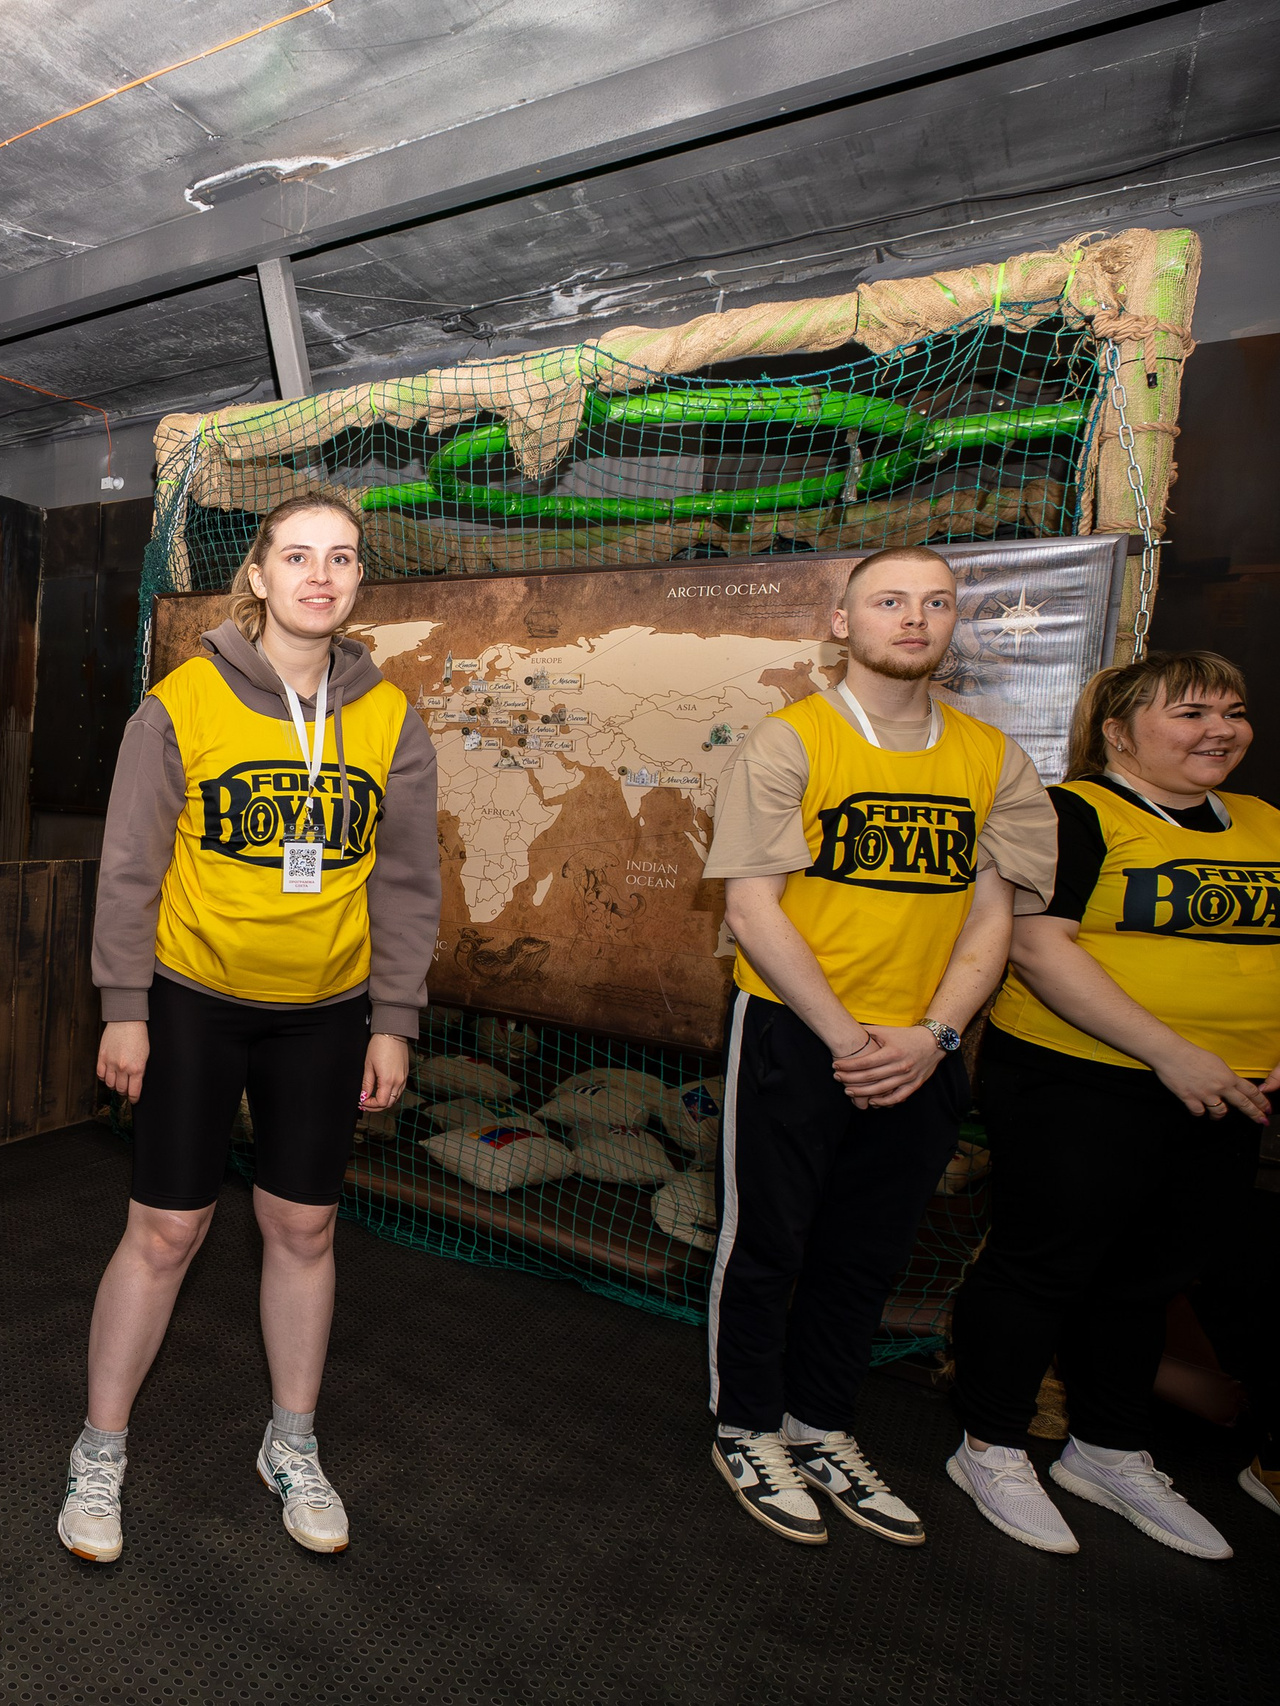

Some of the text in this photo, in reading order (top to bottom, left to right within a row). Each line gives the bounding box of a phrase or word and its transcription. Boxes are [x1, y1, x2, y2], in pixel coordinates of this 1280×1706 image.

[666, 582, 781, 598] ARCTIC OCEAN
[455, 660, 478, 669] London
[551, 677, 580, 685] Moscow
[489, 682, 512, 691] Berlin
[427, 697, 441, 706] Paris
[676, 703, 698, 711] ASIA
[437, 711, 457, 721] Rome
[529, 725, 556, 734] Ankara
[543, 740, 554, 749] Tel
[660, 775, 700, 785] New Delhi
[480, 808, 516, 817] AFRICA
[866, 804, 953, 826] FORT
[626, 860, 679, 874] INDIAN
[625, 874, 677, 889] OCEAN
[1115, 867, 1280, 934] BOYA
